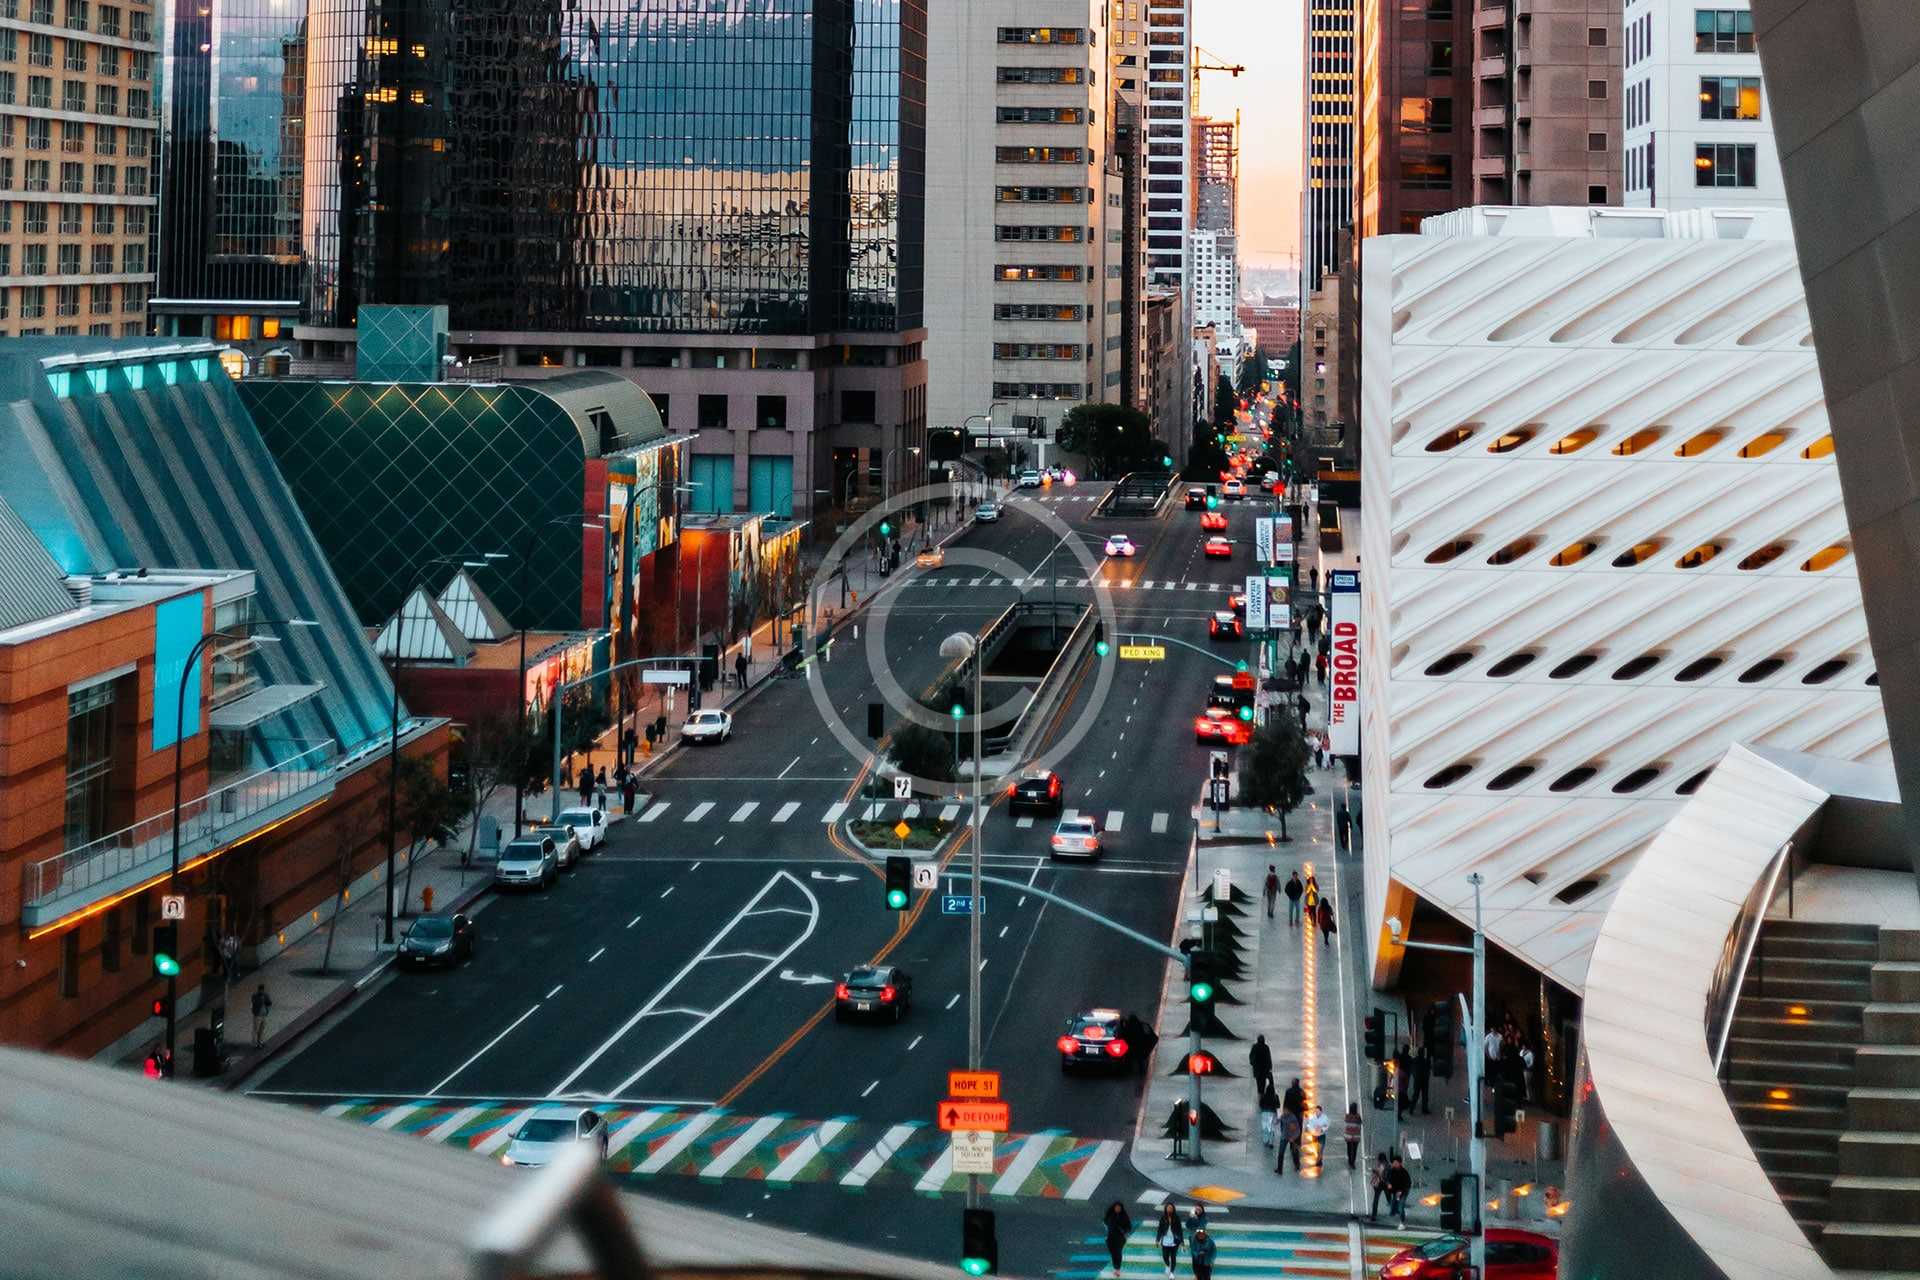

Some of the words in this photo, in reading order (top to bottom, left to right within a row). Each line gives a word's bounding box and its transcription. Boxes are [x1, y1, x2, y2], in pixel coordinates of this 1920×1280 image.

[1333, 622, 1358, 701] BROAD
[1333, 703, 1344, 724] THE
[948, 899, 966, 911] 2nd
[954, 1080, 977, 1090] HOPE
[963, 1111, 1007, 1122] DETOUR
